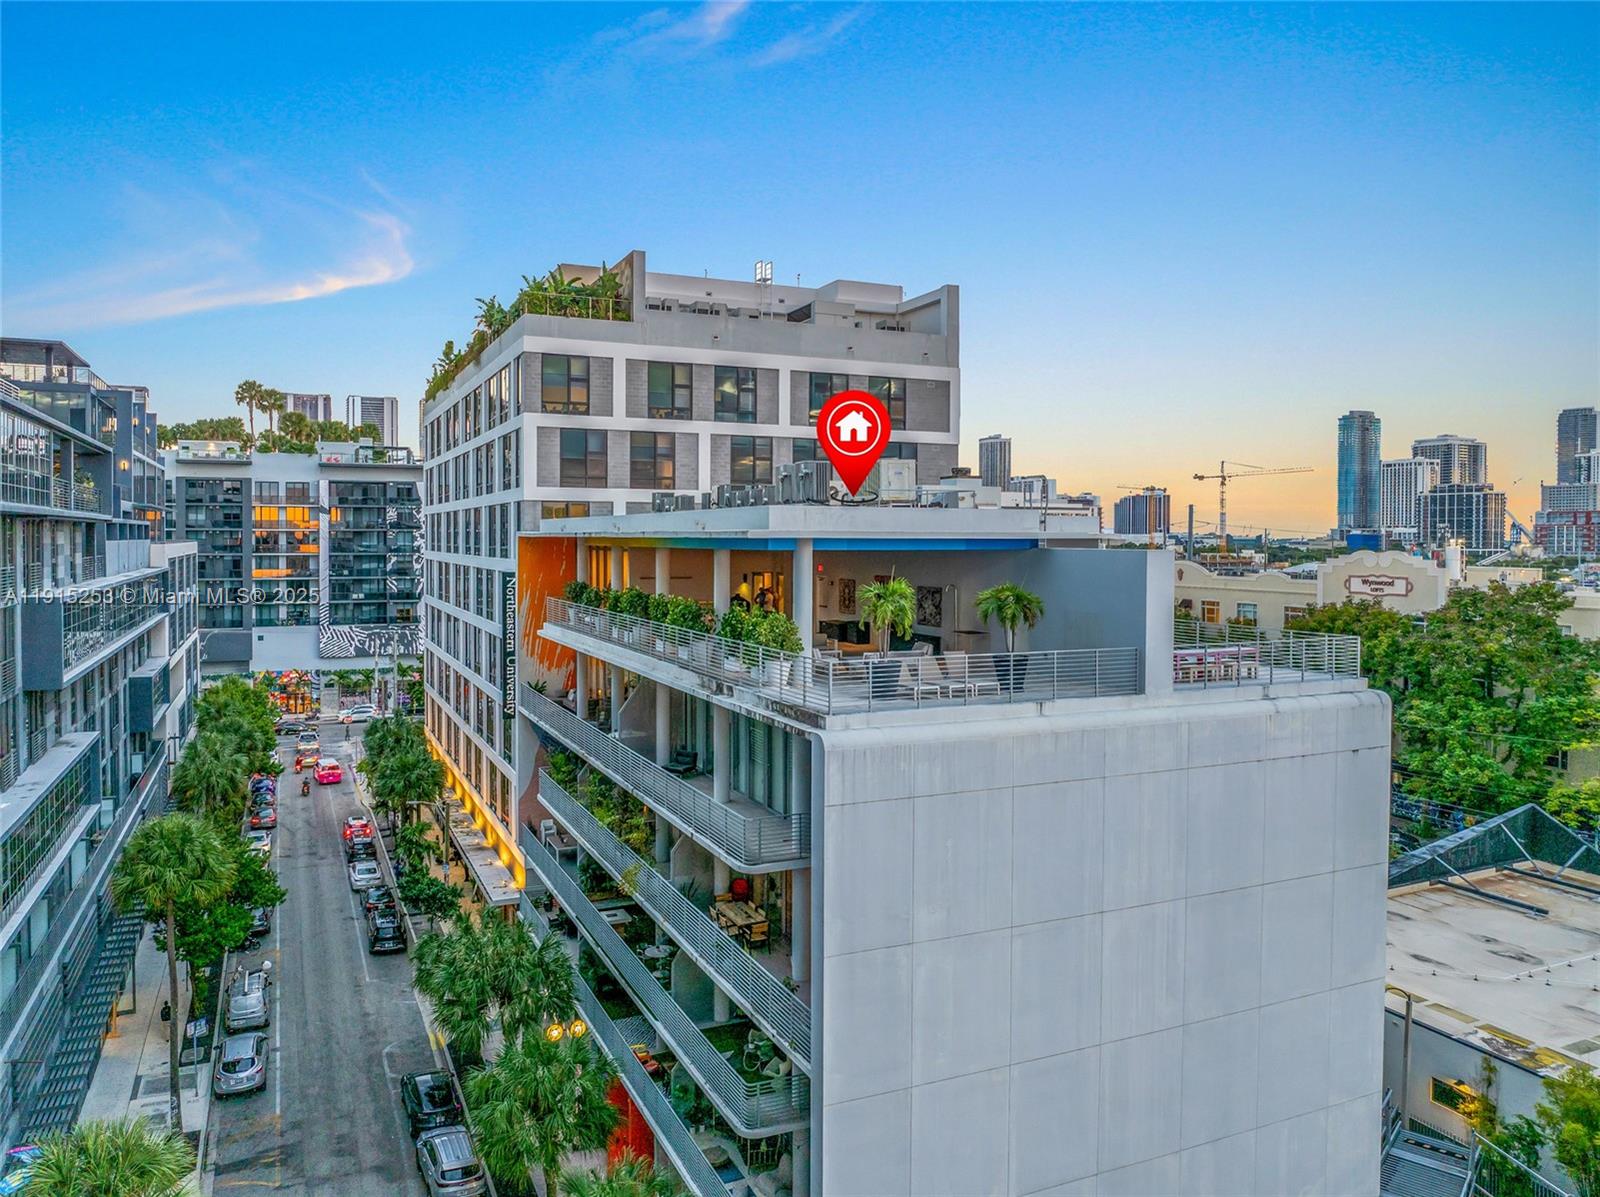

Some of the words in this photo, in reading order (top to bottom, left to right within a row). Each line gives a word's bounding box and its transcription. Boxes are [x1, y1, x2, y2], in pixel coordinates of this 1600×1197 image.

[1361, 579, 1395, 587] Wynwood
[506, 576, 517, 652] Northeastern
[504, 656, 517, 716] University
